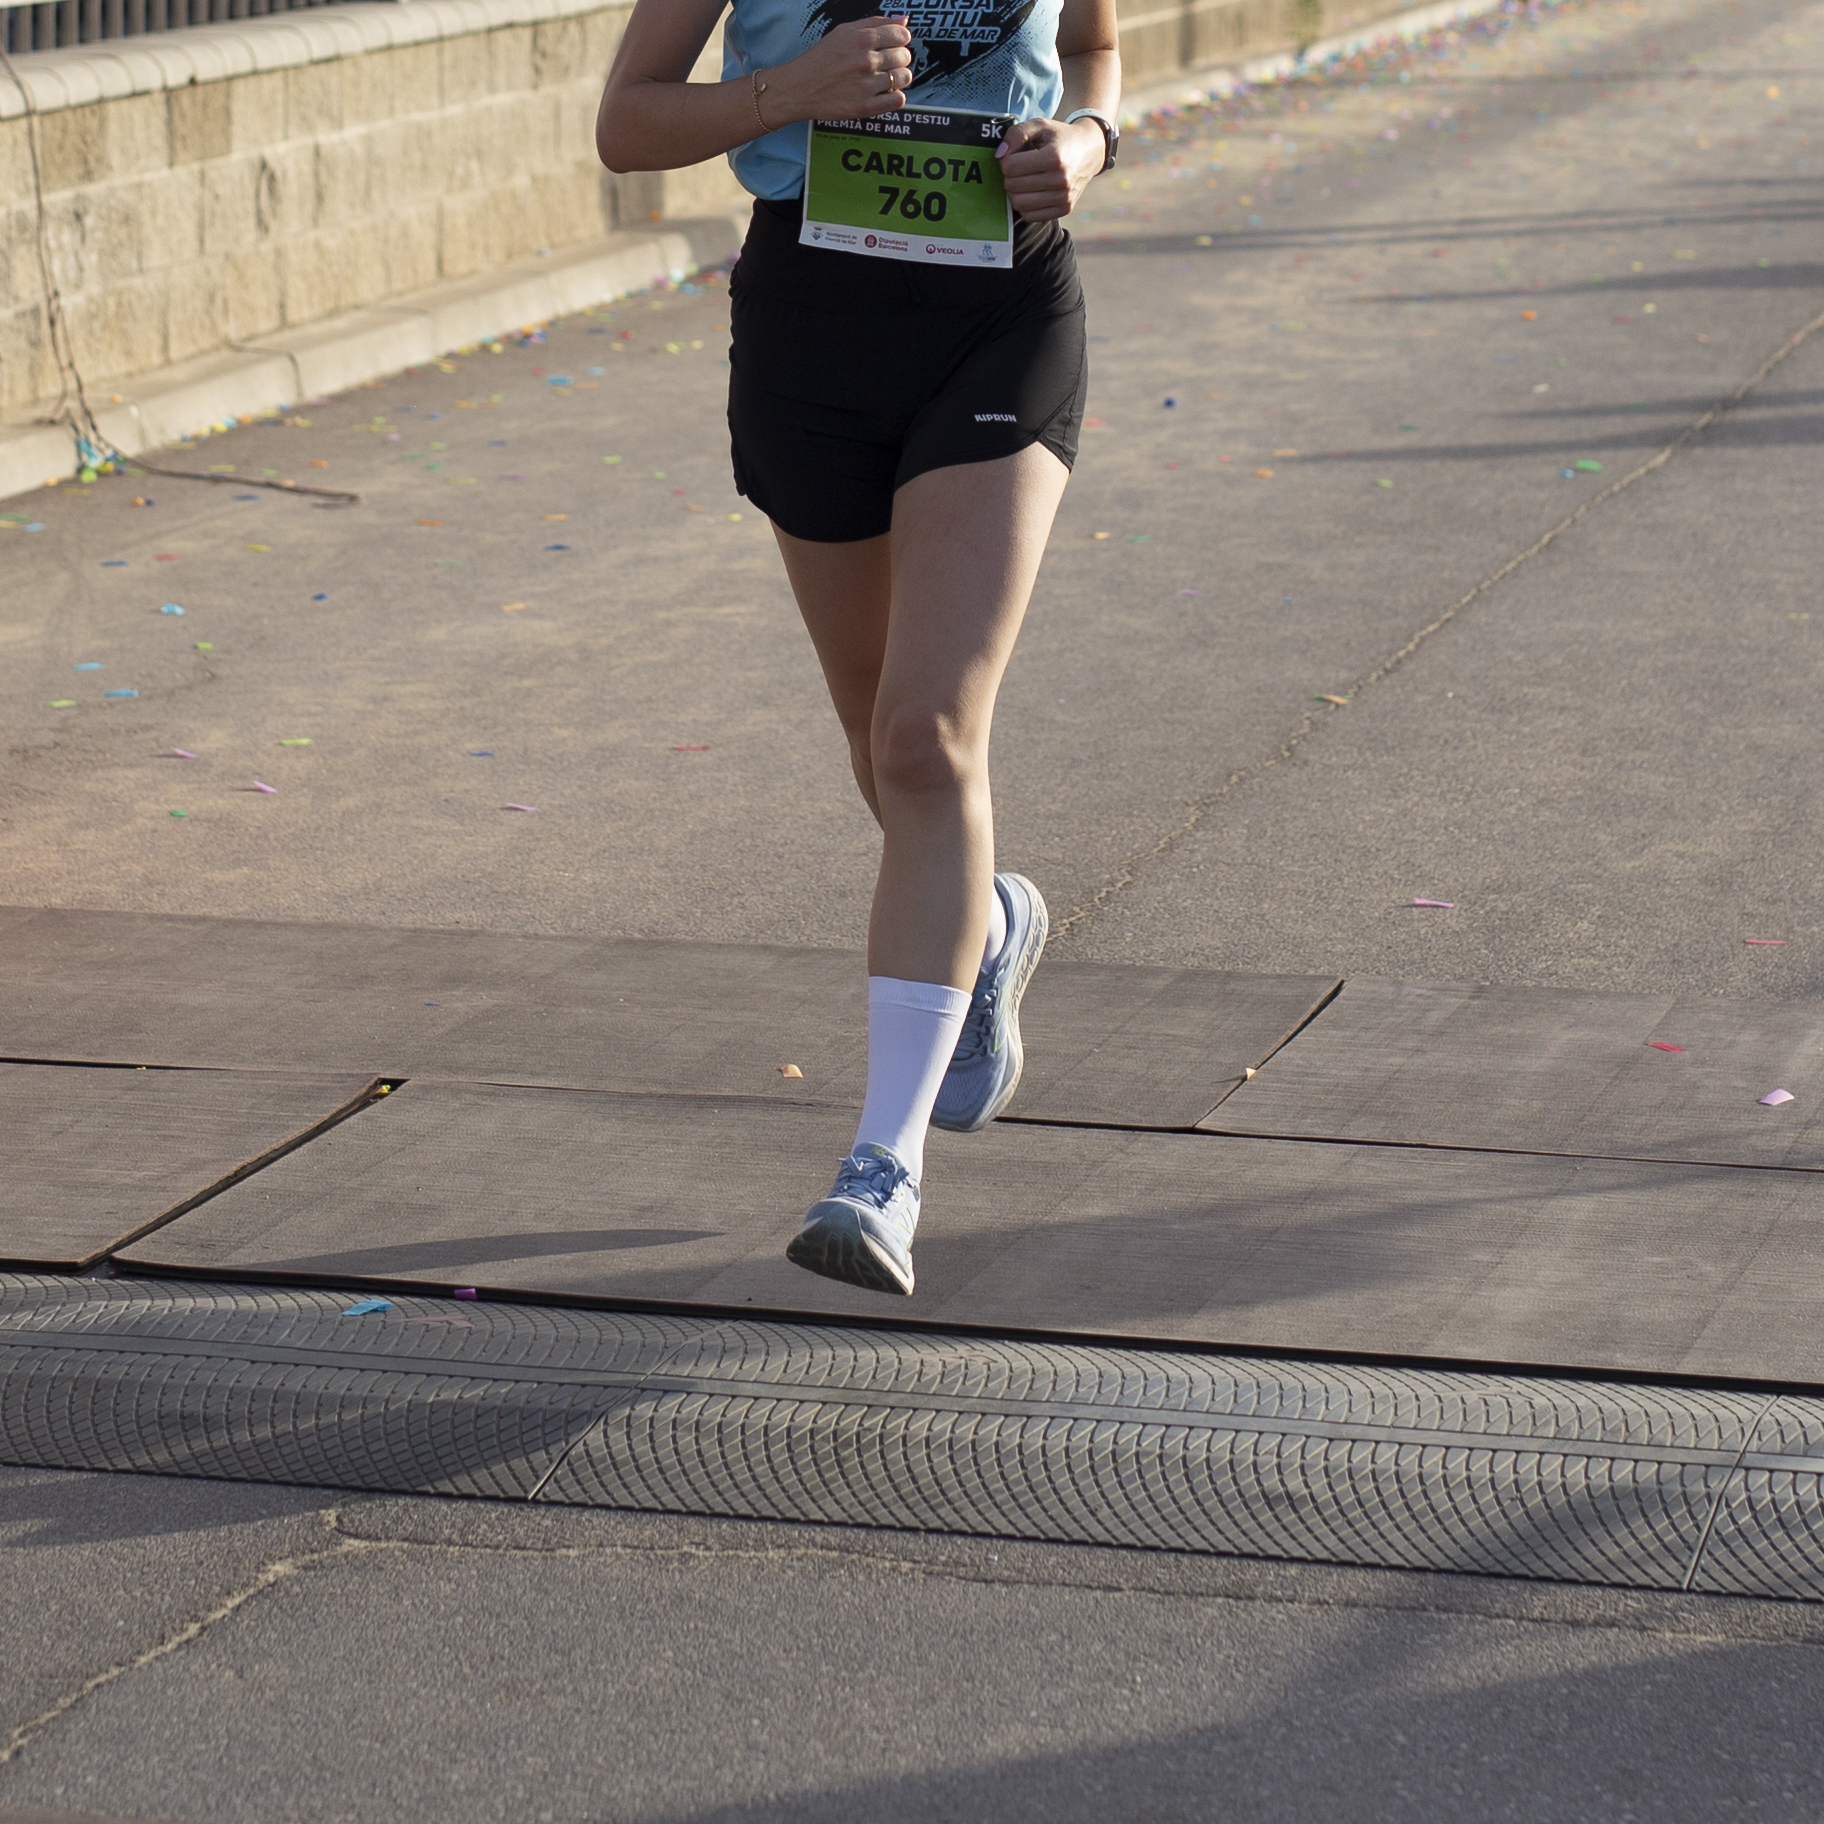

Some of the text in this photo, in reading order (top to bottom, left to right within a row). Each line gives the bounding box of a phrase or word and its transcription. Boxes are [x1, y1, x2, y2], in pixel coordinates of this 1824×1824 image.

[935, 28, 958, 39] DE
[958, 28, 997, 41] MAR
[865, 122, 881, 133] DE
[884, 124, 911, 135] MAR
[980, 124, 1002, 139] 5K
[841, 148, 983, 184] CARLOTA
[878, 185, 947, 222] 760
[937, 247, 964, 255] VEOLIA
